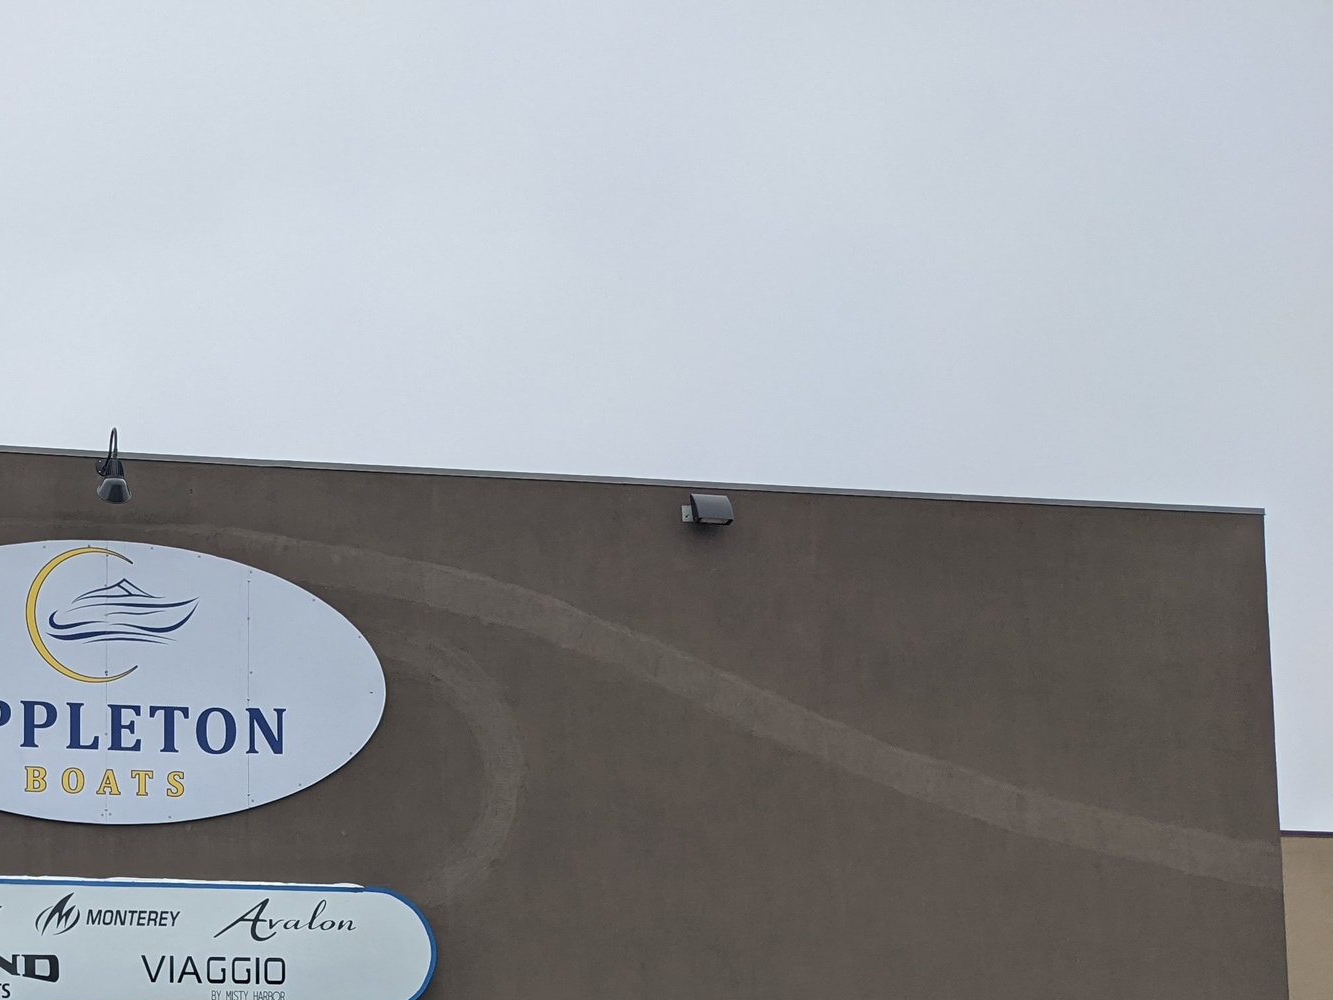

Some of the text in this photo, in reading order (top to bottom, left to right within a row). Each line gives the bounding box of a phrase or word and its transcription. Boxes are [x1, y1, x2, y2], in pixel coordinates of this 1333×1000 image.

[24, 765, 186, 798] BOATS
[86, 908, 181, 927] MONTEREY
[213, 897, 357, 942] Avalon
[141, 954, 286, 986] VIAGGIO
